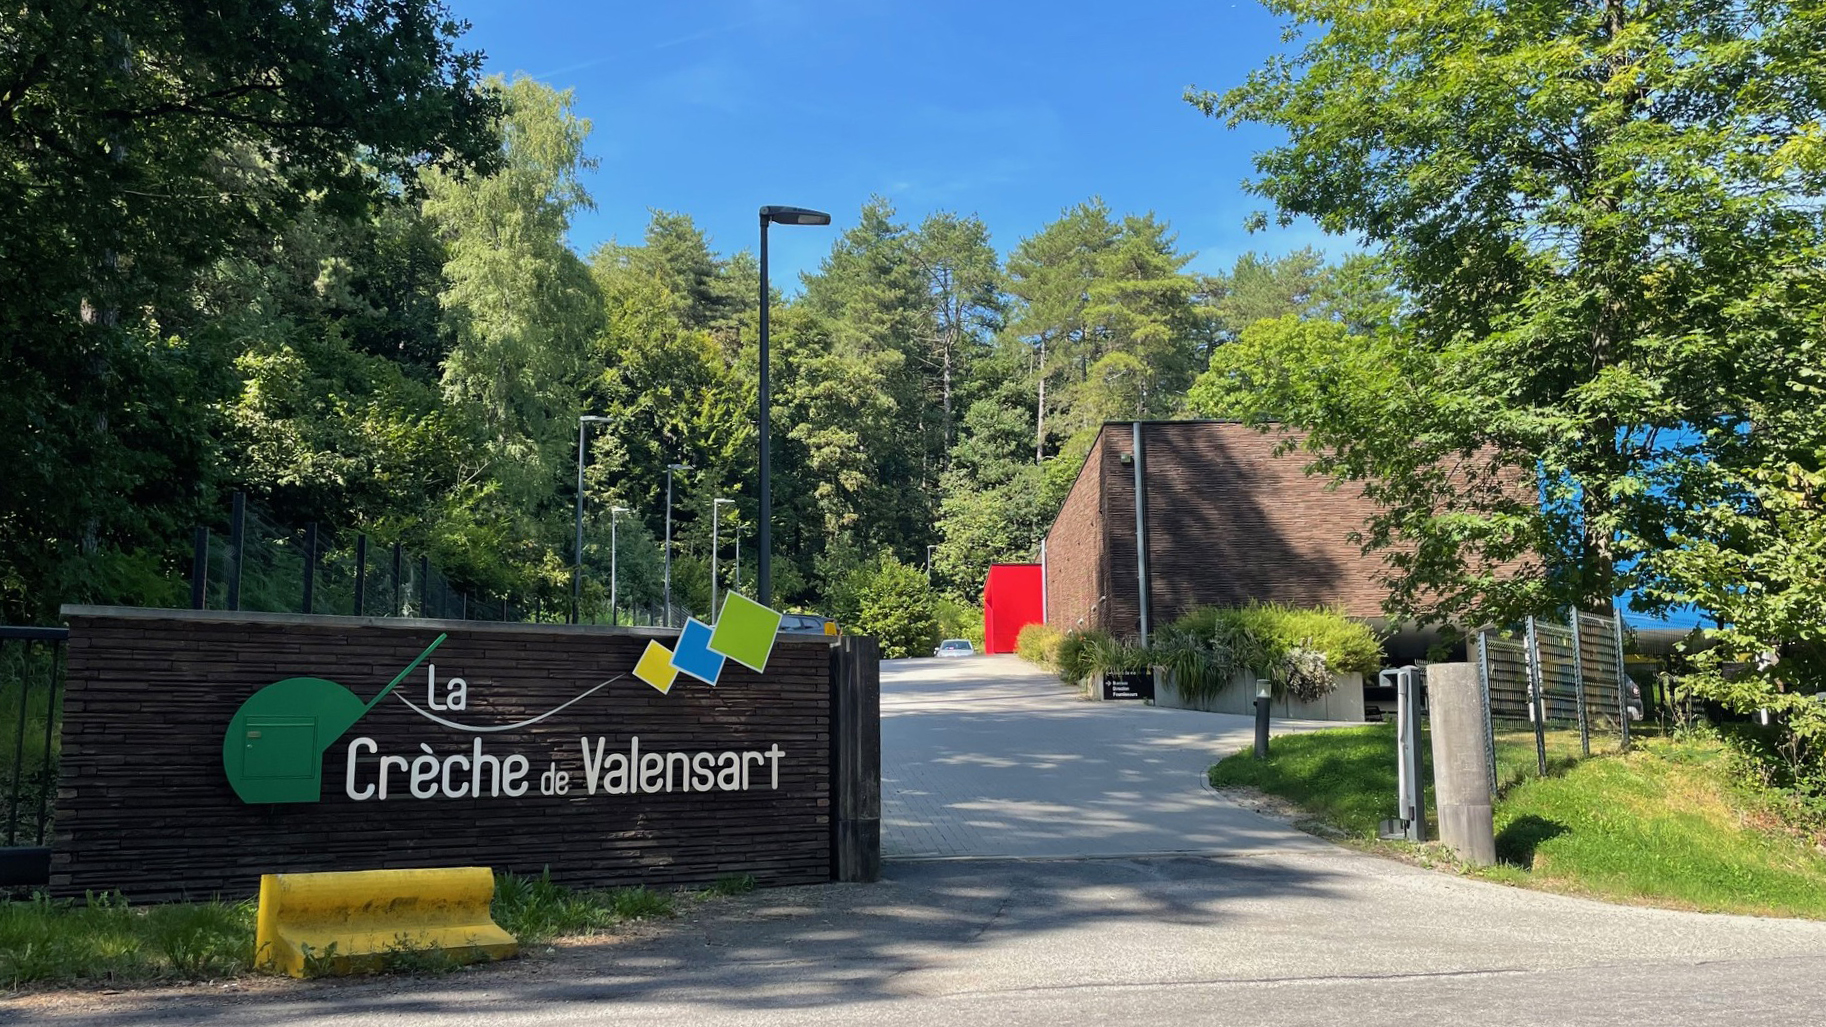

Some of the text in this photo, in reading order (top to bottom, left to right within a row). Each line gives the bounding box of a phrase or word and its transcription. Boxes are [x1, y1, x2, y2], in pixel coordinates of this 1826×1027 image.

[427, 663, 467, 711] La
[346, 736, 786, 801] Crèche de Valensart
